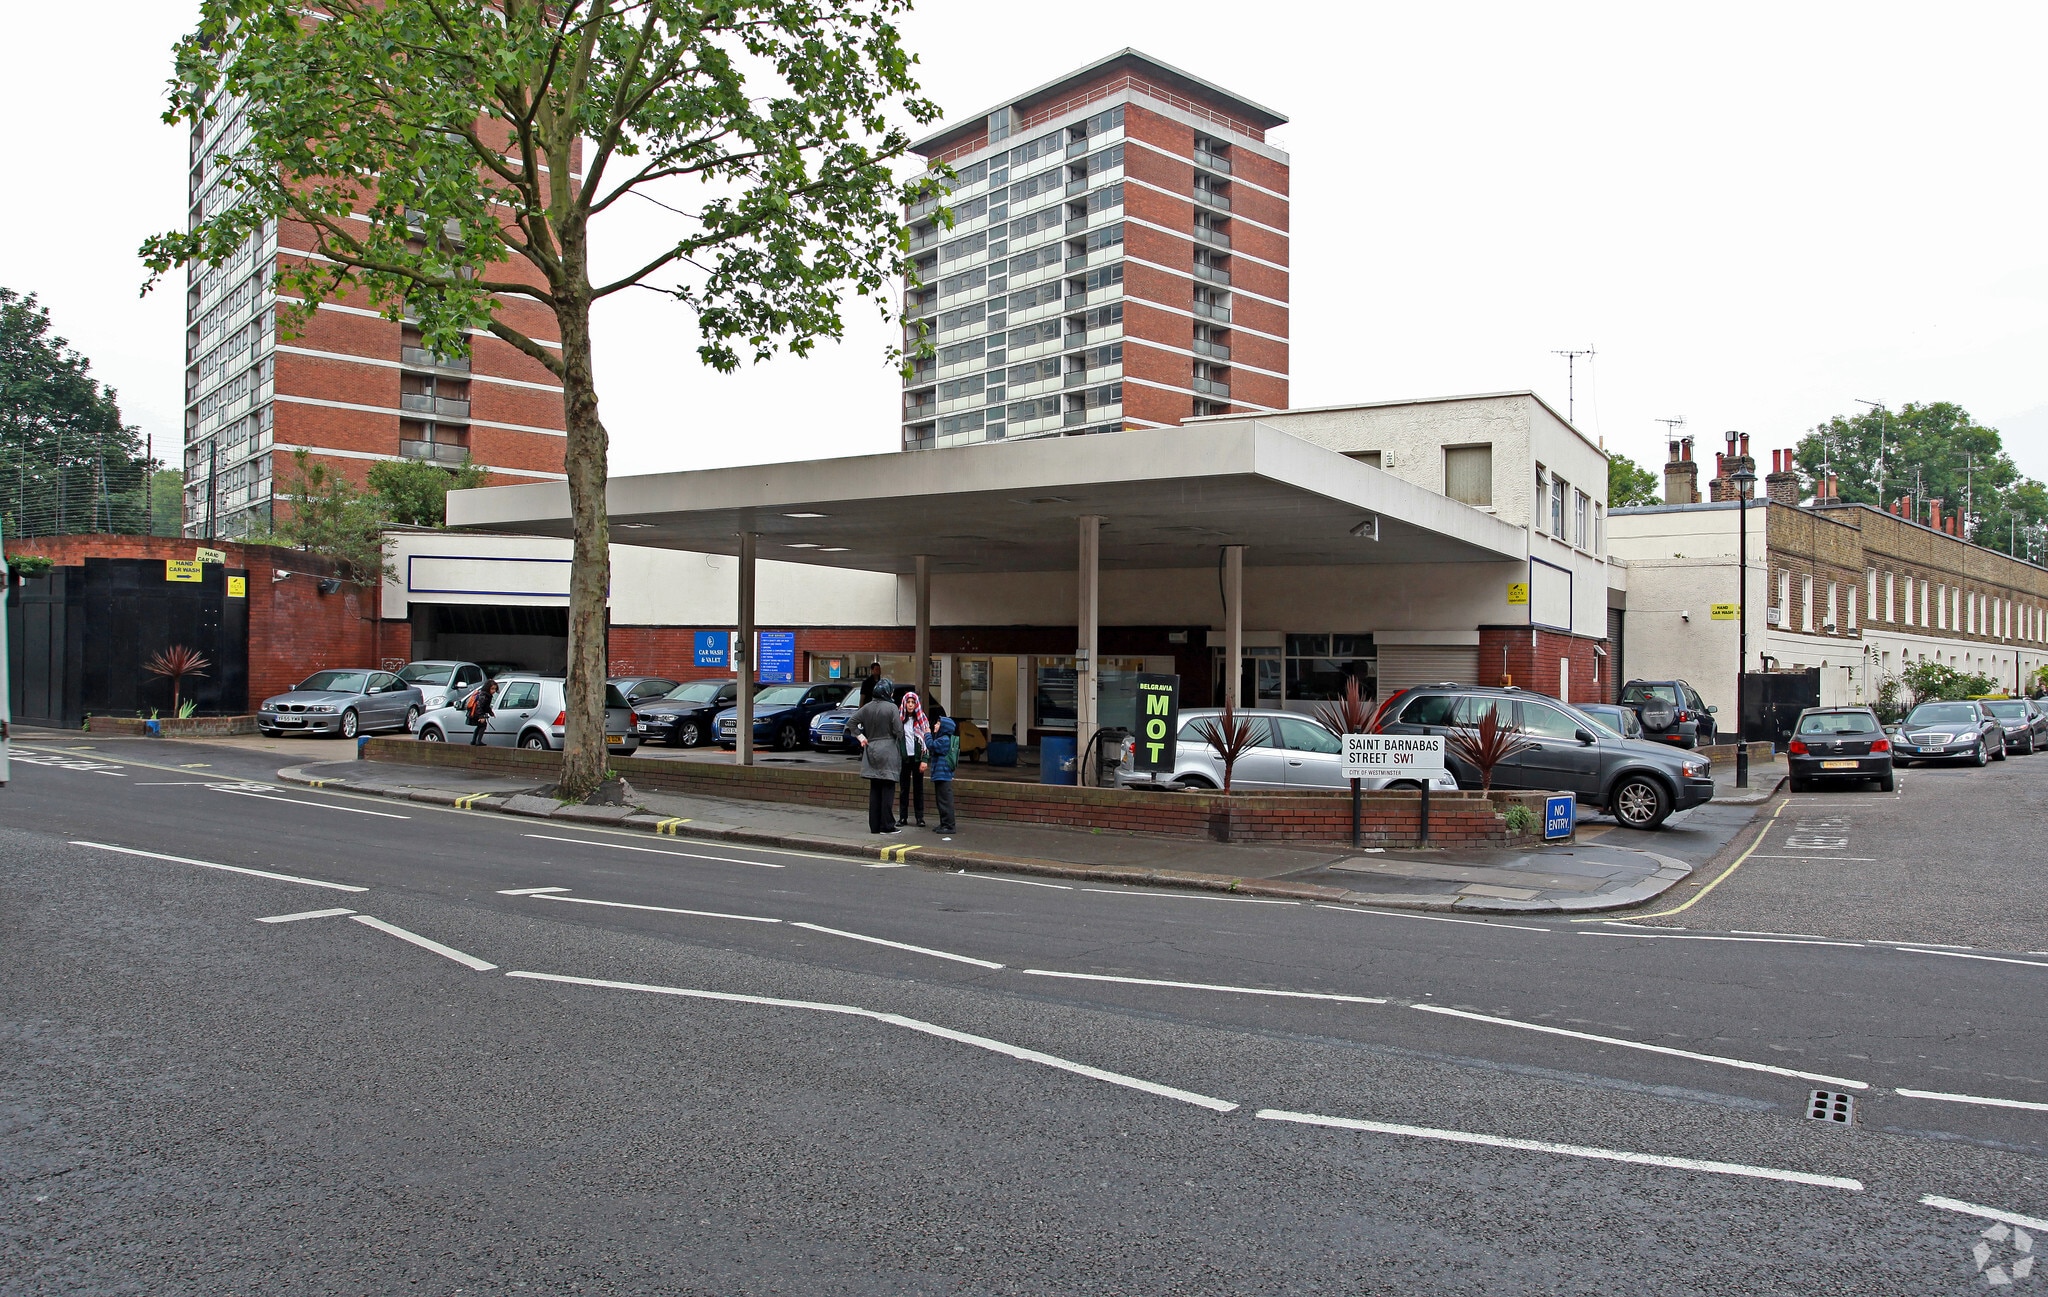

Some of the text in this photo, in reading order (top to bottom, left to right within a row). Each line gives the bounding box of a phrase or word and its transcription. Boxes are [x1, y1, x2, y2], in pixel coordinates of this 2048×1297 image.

[1140, 683, 1172, 692] BELGRAVIA
[1146, 695, 1169, 763] MOT
[1349, 739, 1439, 751] SAINT BARNABAS
[1349, 753, 1414, 764] STREET SW1
[1554, 805, 1565, 816] NO
